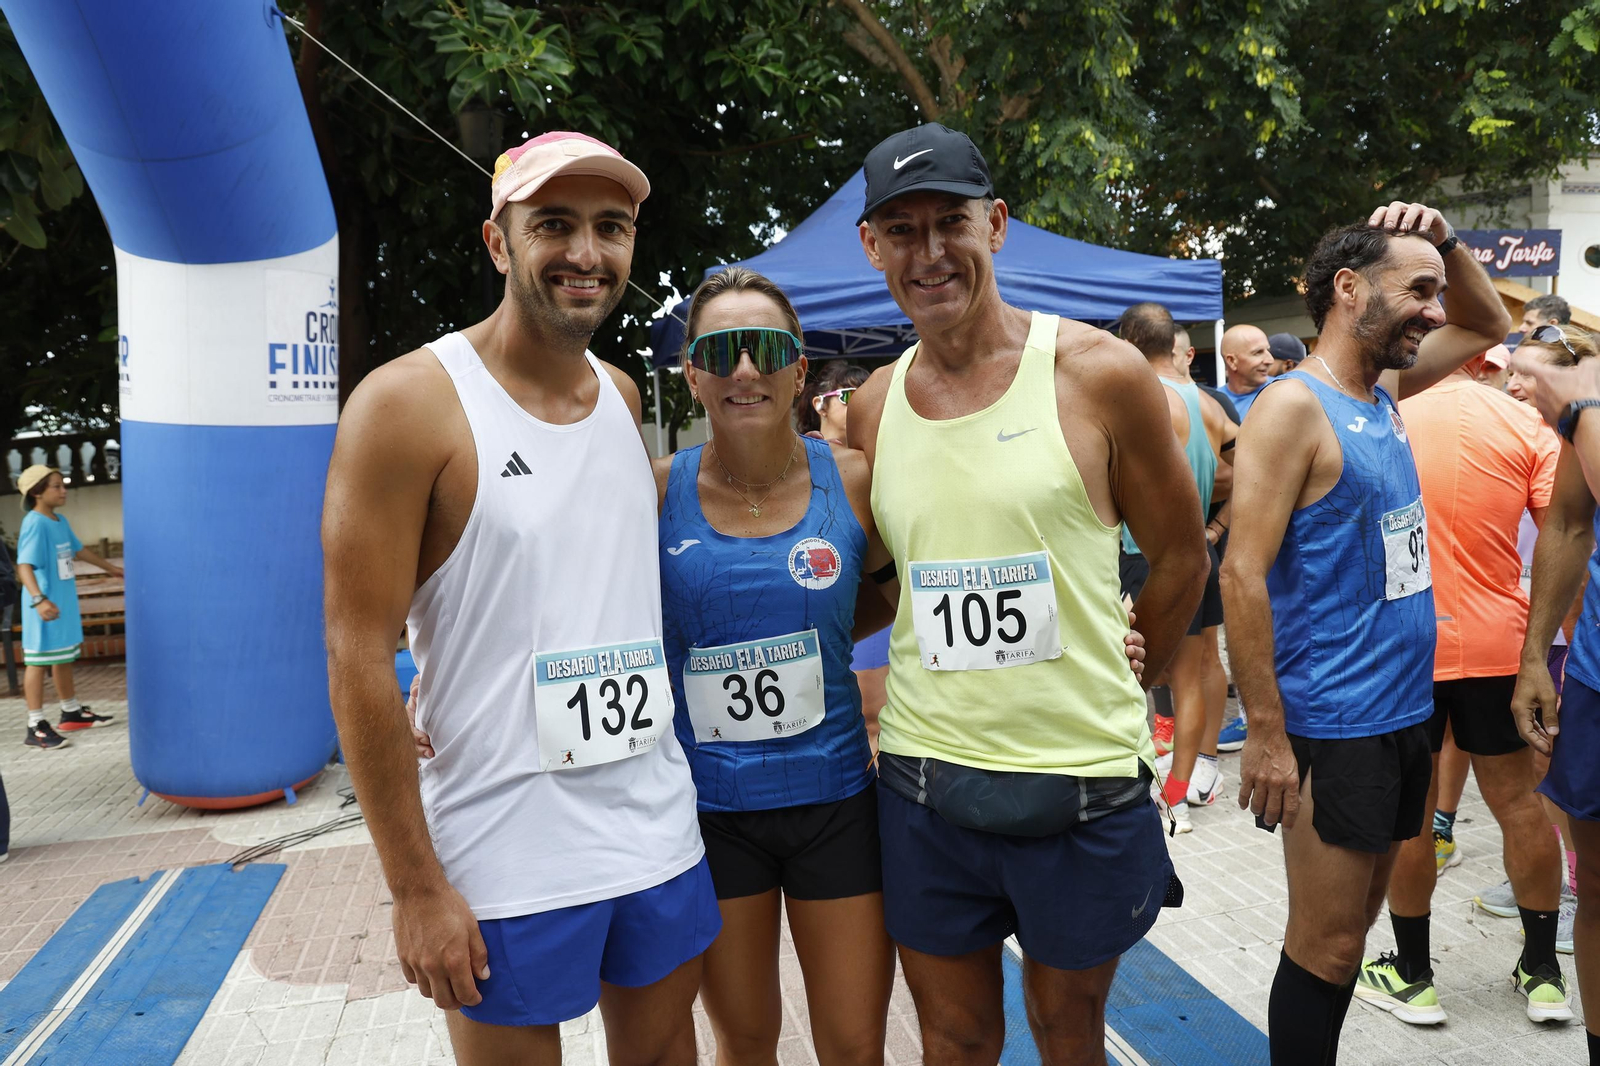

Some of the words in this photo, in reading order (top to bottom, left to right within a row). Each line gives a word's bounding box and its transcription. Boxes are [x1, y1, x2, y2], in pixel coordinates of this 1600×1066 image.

[1495, 235, 1555, 270] Tarifa
[306, 311, 338, 344] CRO
[919, 566, 959, 588] DESAFÍO
[961, 565, 993, 591] ELA
[993, 563, 1037, 585] TARIFA
[932, 589, 1027, 648] 105
[547, 654, 596, 680] DESAFÍO
[598, 649, 625, 677] ELA
[623, 648, 656, 669] TARIFA
[690, 652, 734, 672] DESAFÍO
[735, 645, 768, 671] ELA
[766, 640, 807, 663] TARIFA
[1005, 650, 1035, 660] TARIFA
[567, 674, 653, 741] 132
[722, 669, 785, 722] 36
[782, 718, 808, 730] TARIFA
[635, 736, 657, 747] TARIFA
